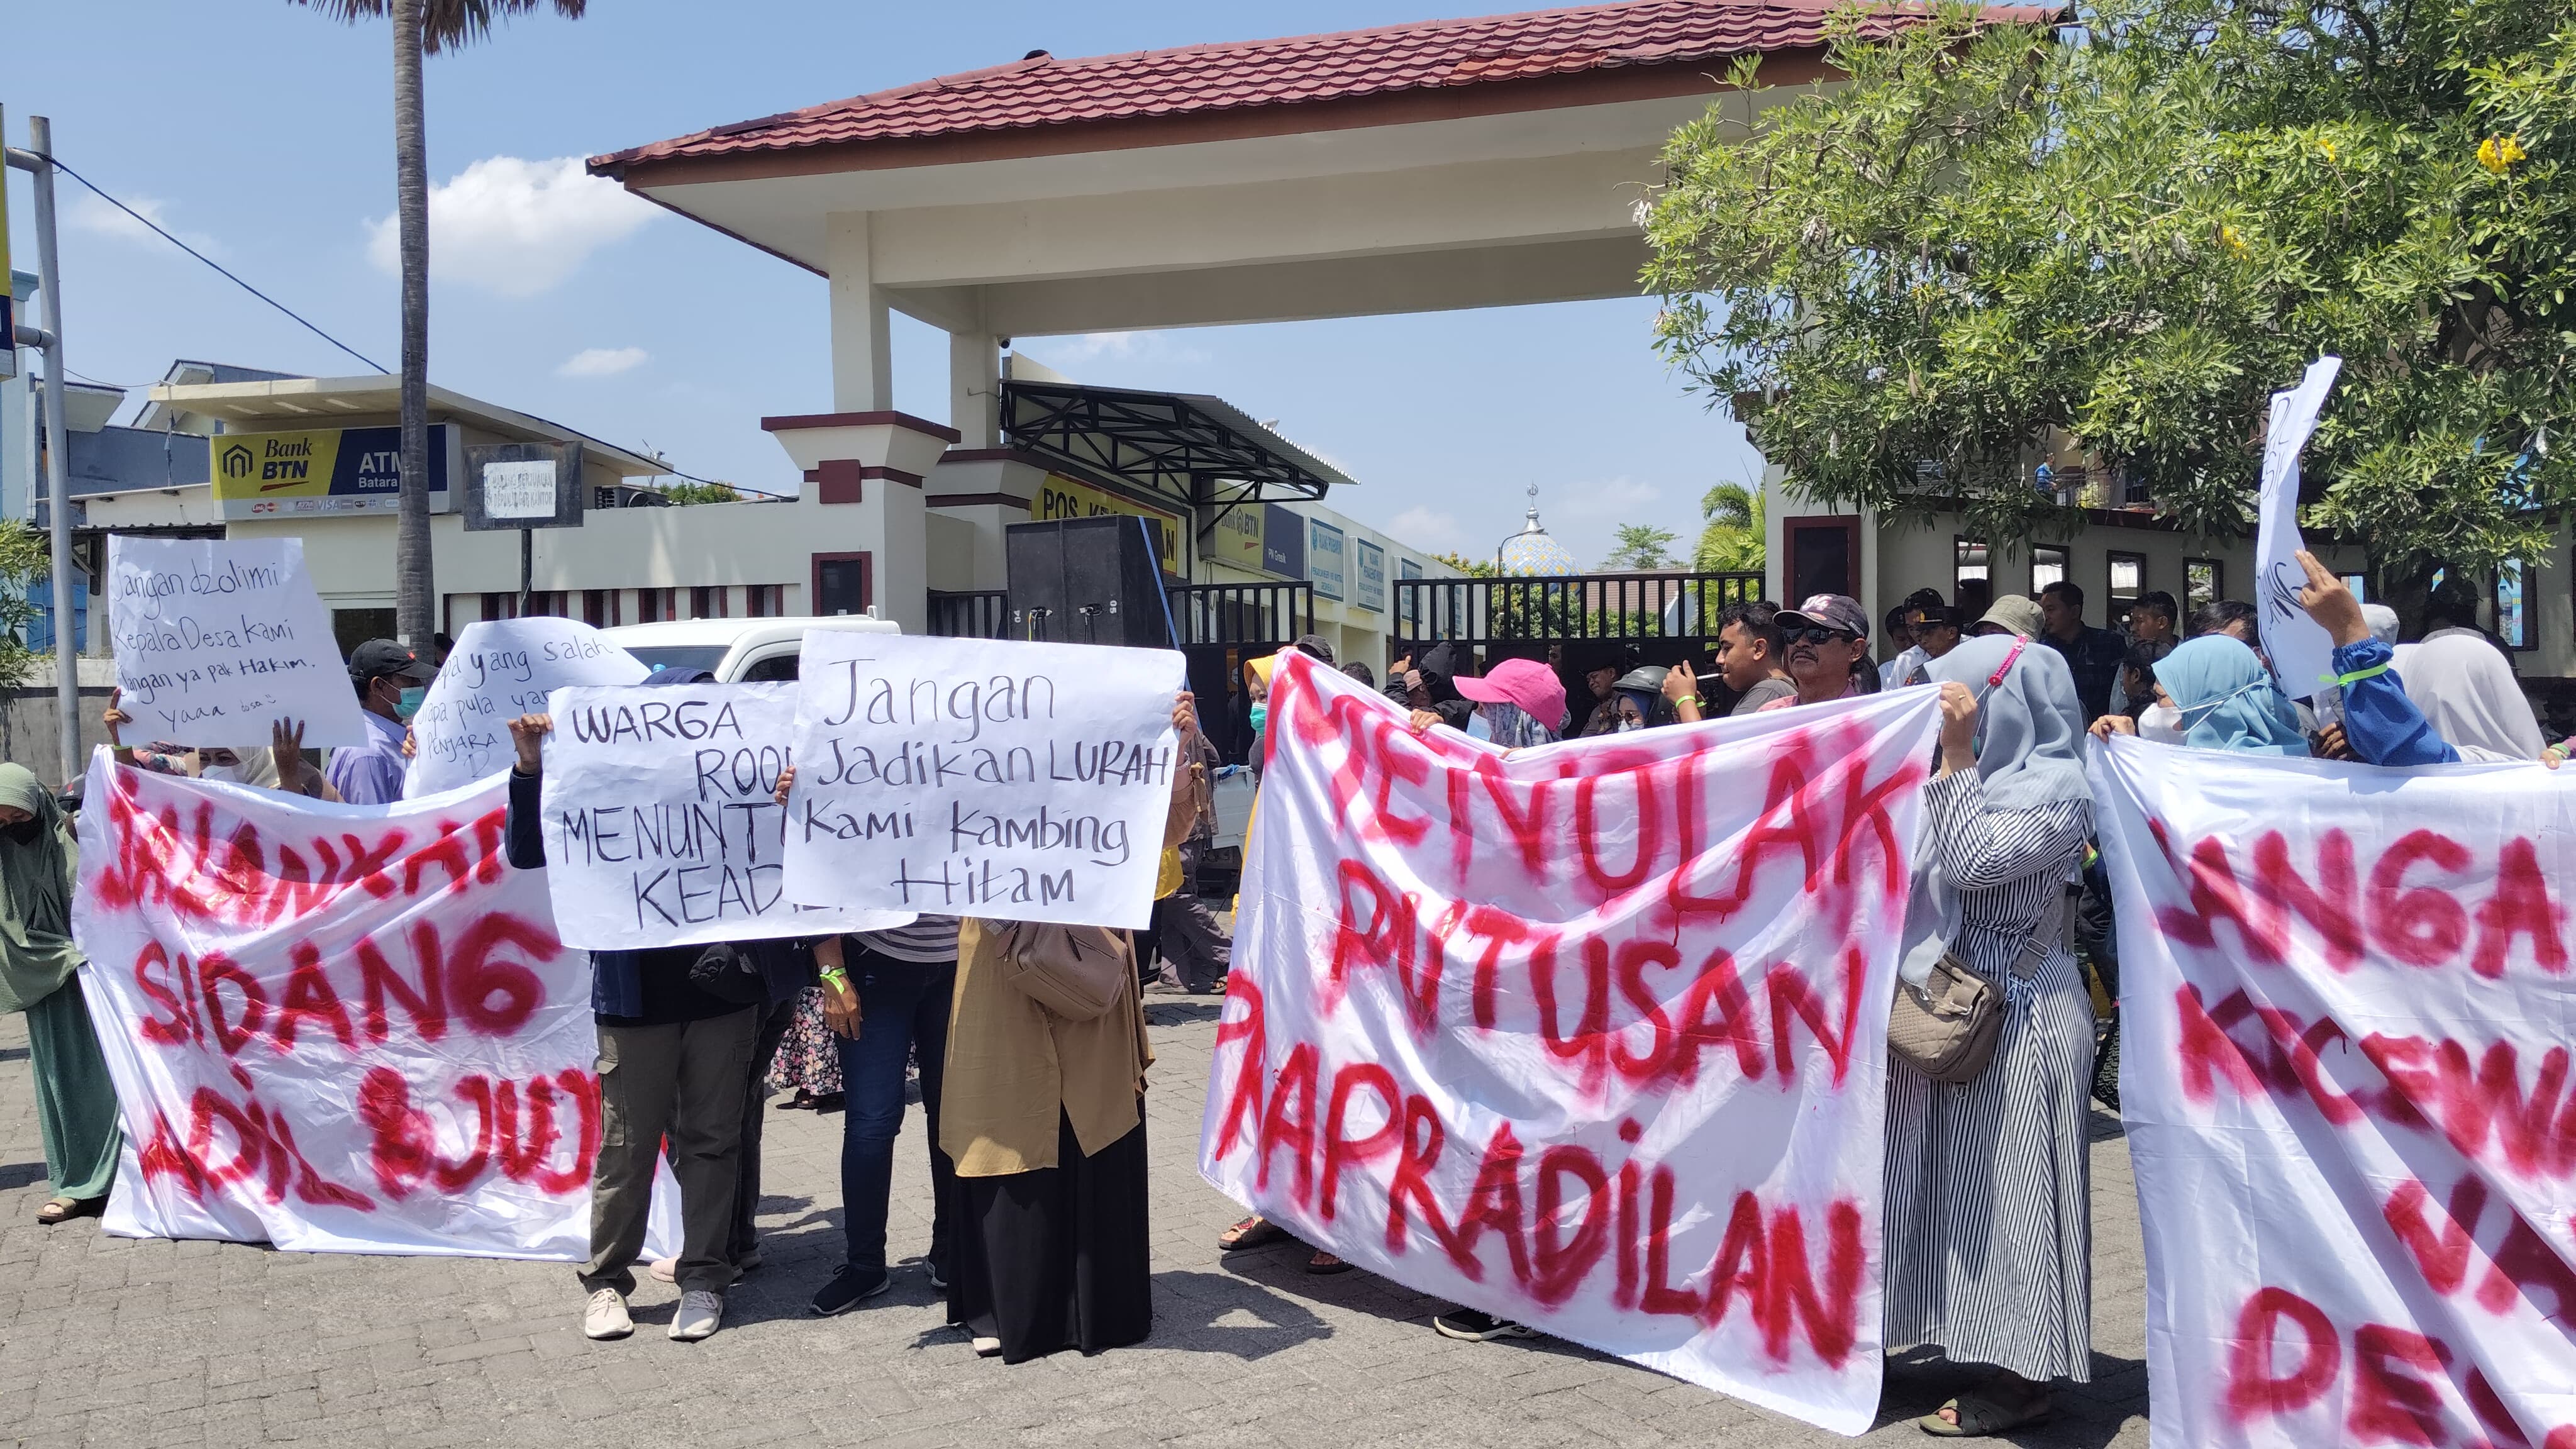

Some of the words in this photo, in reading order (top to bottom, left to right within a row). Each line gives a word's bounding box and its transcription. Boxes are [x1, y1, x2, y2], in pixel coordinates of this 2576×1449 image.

[264, 438, 313, 458] Bank
[261, 460, 309, 480] BTN
[358, 477, 398, 489] Batara
[317, 499, 338, 510] VISA
[1043, 487, 1079, 520] POS
[1221, 504, 1236, 531] Bank
[1244, 513, 1258, 538] BTN
[1268, 548, 1274, 560] PN
[1274, 550, 1287, 564] Gresik
[111, 554, 185, 620] Jangan
[1109, 600, 1118, 614] 05
[112, 617, 182, 662] Kepala
[179, 616, 242, 650] Desa
[176, 669, 202, 692] ya
[467, 650, 533, 689] yang
[455, 694, 495, 731] pula
[823, 657, 1055, 744] Jangan
[572, 700, 744, 744] WARGA
[426, 732, 499, 763] PENJARA
[816, 737, 1036, 789] Jadikan
[1050, 738, 1169, 787] LURAH
[696, 745, 791, 803] ROO
[562, 801, 786, 866] MENUNT
[134, 911, 564, 1054] SIDANG
[1324, 857, 1870, 1102] PUTUSAN
